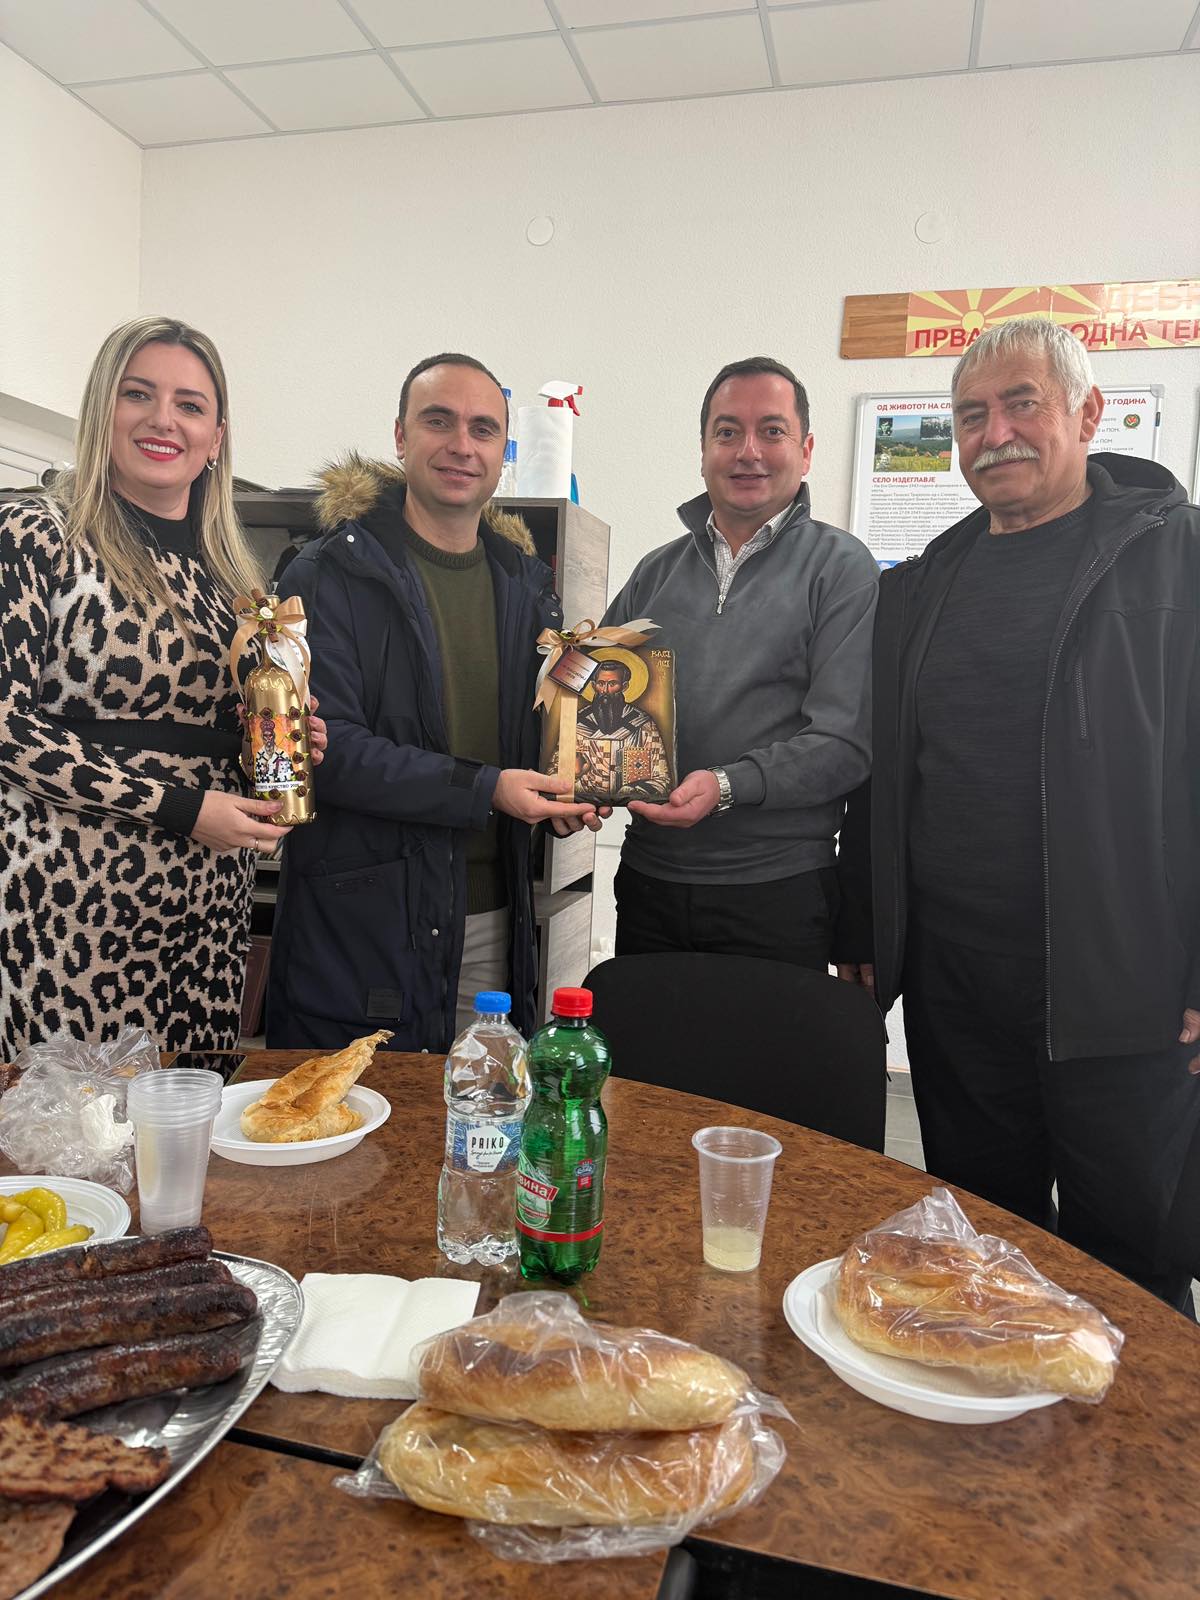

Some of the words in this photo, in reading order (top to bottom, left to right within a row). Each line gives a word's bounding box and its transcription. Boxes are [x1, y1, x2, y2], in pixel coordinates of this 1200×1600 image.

[915, 328, 981, 348] ПРВА
[1070, 320, 1148, 346] ОДНА
[1112, 398, 1147, 406] ГОДИНА
[892, 476, 936, 484] ИЗДЕГЛАВЈЕ
[471, 1136, 504, 1149] PAIKO
